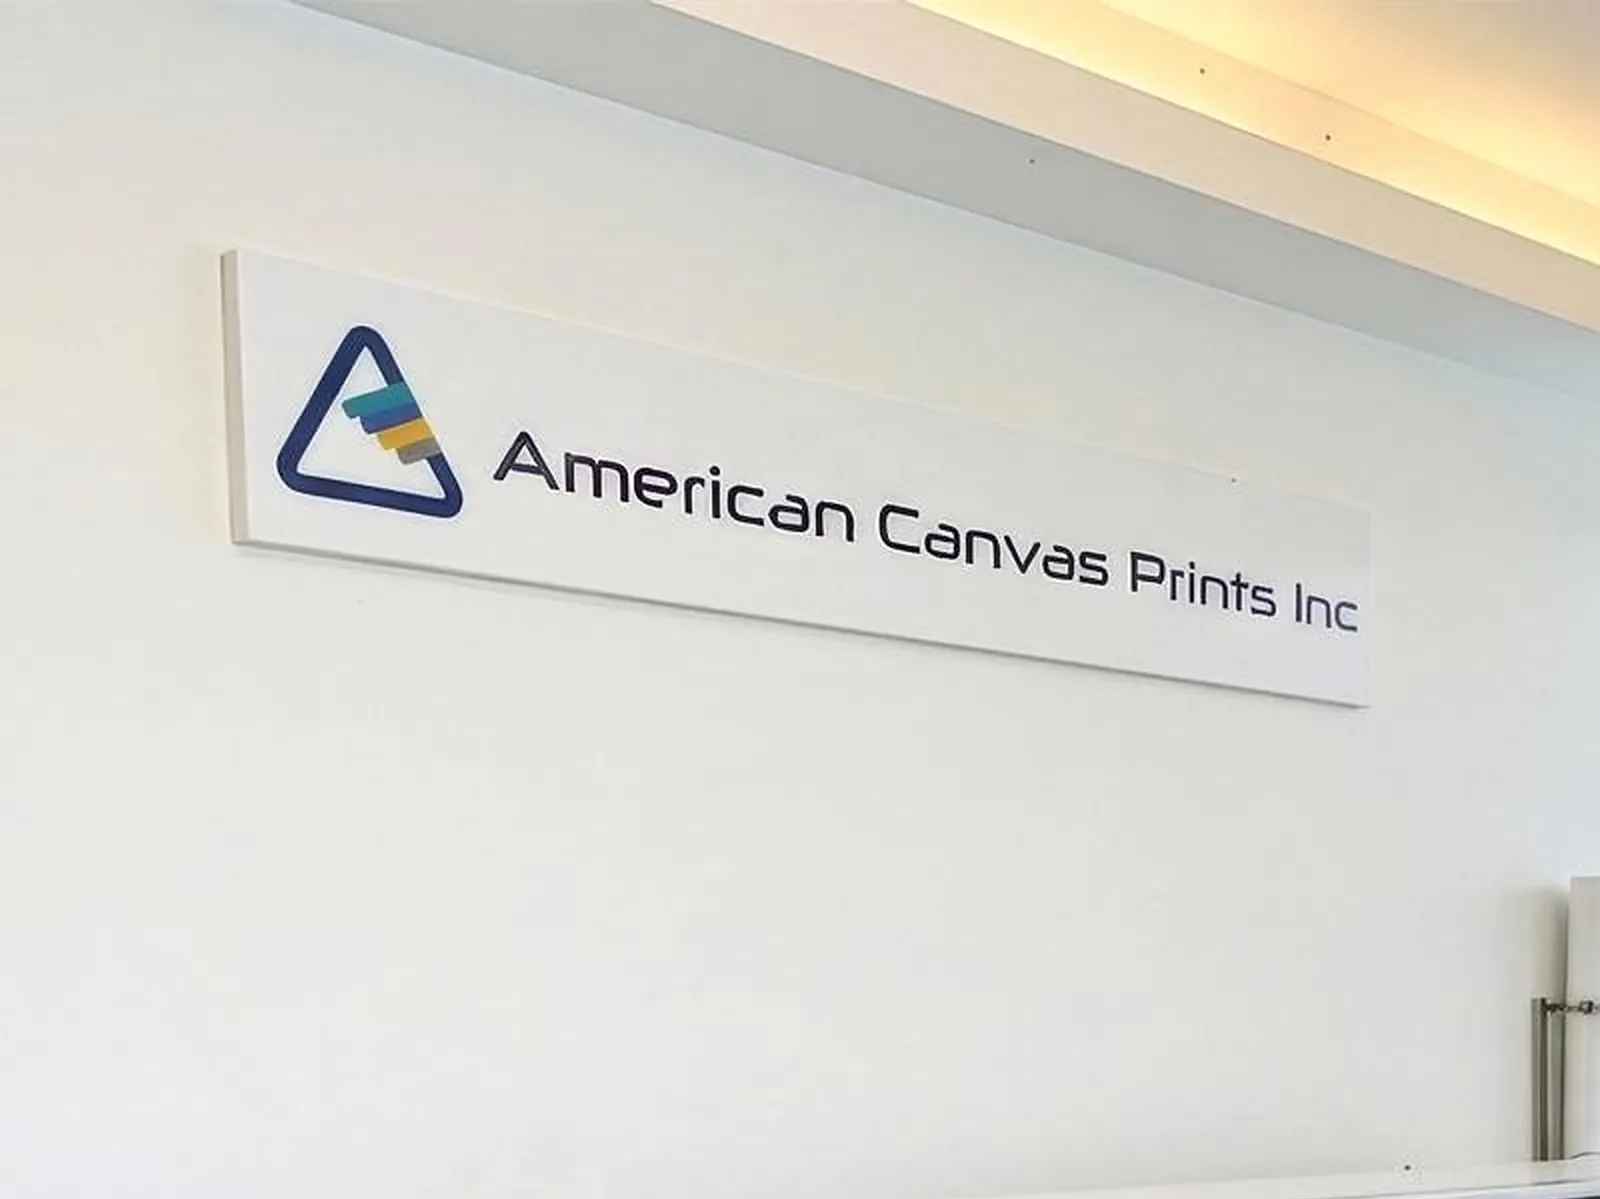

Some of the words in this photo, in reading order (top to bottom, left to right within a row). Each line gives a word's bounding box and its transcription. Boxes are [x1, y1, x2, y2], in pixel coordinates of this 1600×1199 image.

[493, 431, 855, 543] American
[878, 503, 1109, 587] Canvas
[1130, 551, 1277, 617] Prints
[1295, 583, 1359, 632] Inc
